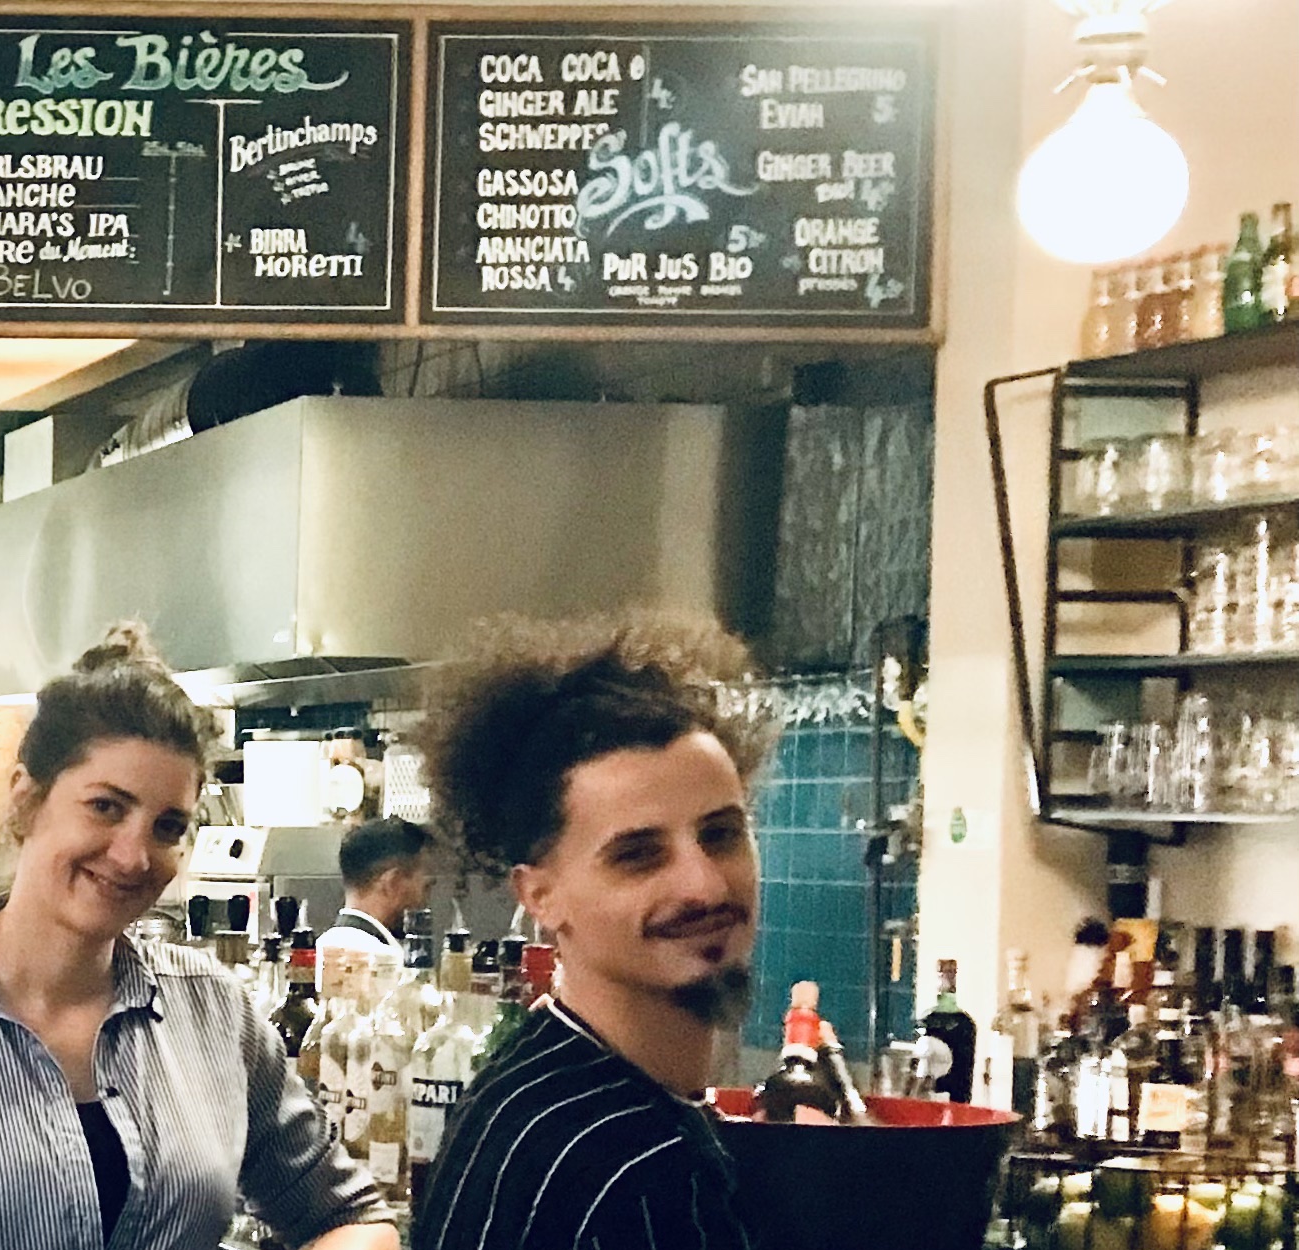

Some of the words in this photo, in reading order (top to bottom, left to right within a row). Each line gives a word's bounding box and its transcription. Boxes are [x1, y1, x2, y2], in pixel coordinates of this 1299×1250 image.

[14, 33, 114, 94] Les
[115, 31, 349, 93] Bières
[480, 54, 544, 83] COCA
[561, 51, 623, 82] COCA
[479, 89, 565, 117] GINGER
[573, 89, 620, 116] ALE
[229, 115, 378, 173] Bertinchamps
[477, 168, 579, 197] GASSOSA
[575, 121, 760, 232] Softs
[88, 213, 130, 238] IPA
[476, 202, 577, 230] CHINOTTO
[249, 228, 308, 254] BIRRA
[795, 217, 880, 247] ORANGE
[476, 236, 590, 264] ARANCIATA
[808, 248, 885, 275] CITRON
[481, 265, 553, 293] ROSSA
[413, 1083, 458, 1104] PARI
